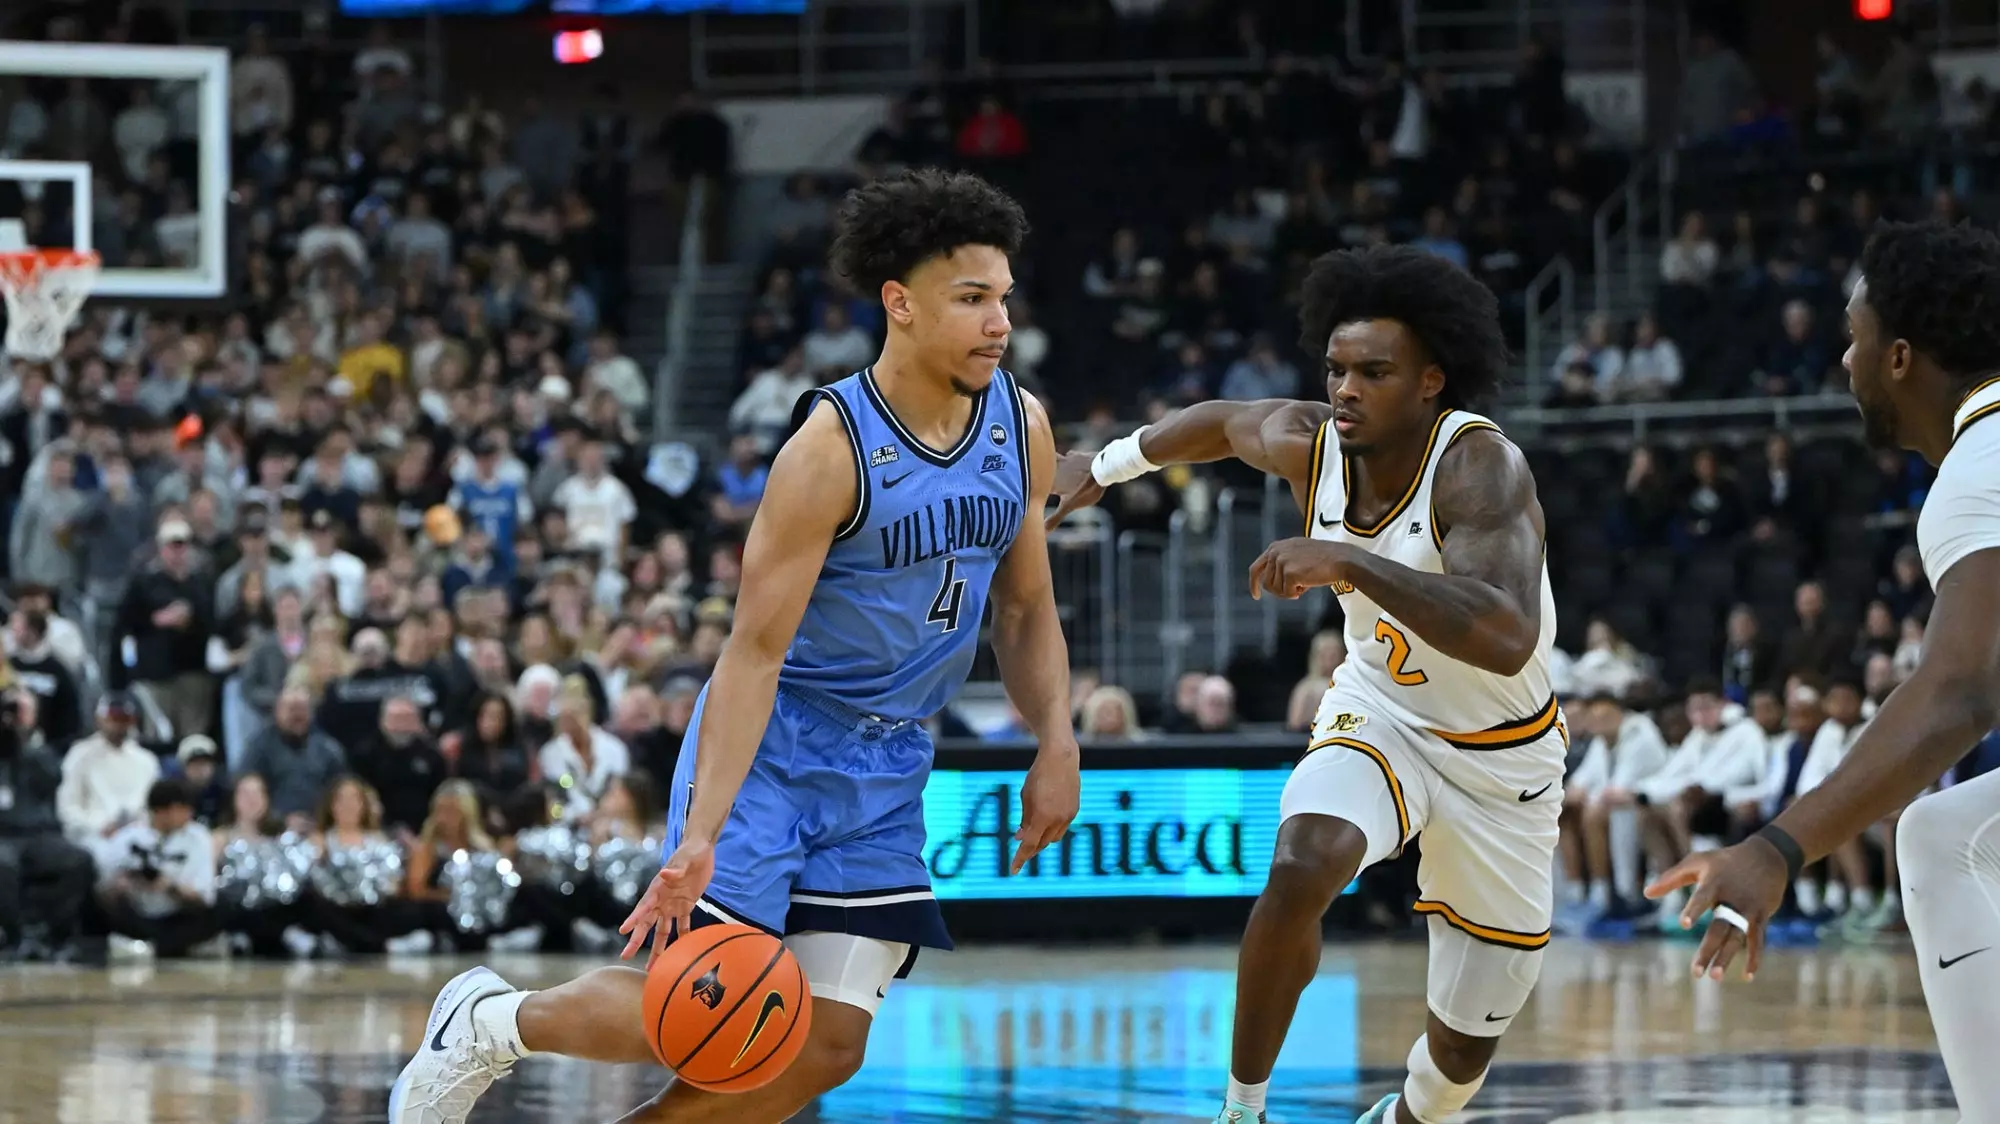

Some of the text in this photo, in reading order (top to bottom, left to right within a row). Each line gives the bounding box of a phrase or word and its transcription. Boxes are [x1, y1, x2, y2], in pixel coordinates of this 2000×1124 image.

[870, 452, 899, 467] CHANGE
[871, 448, 882, 459] BE
[981, 461, 1007, 470] EAST
[880, 494, 1018, 569] VILLANOVA
[925, 556, 967, 633] 4
[1374, 617, 1429, 687] 2
